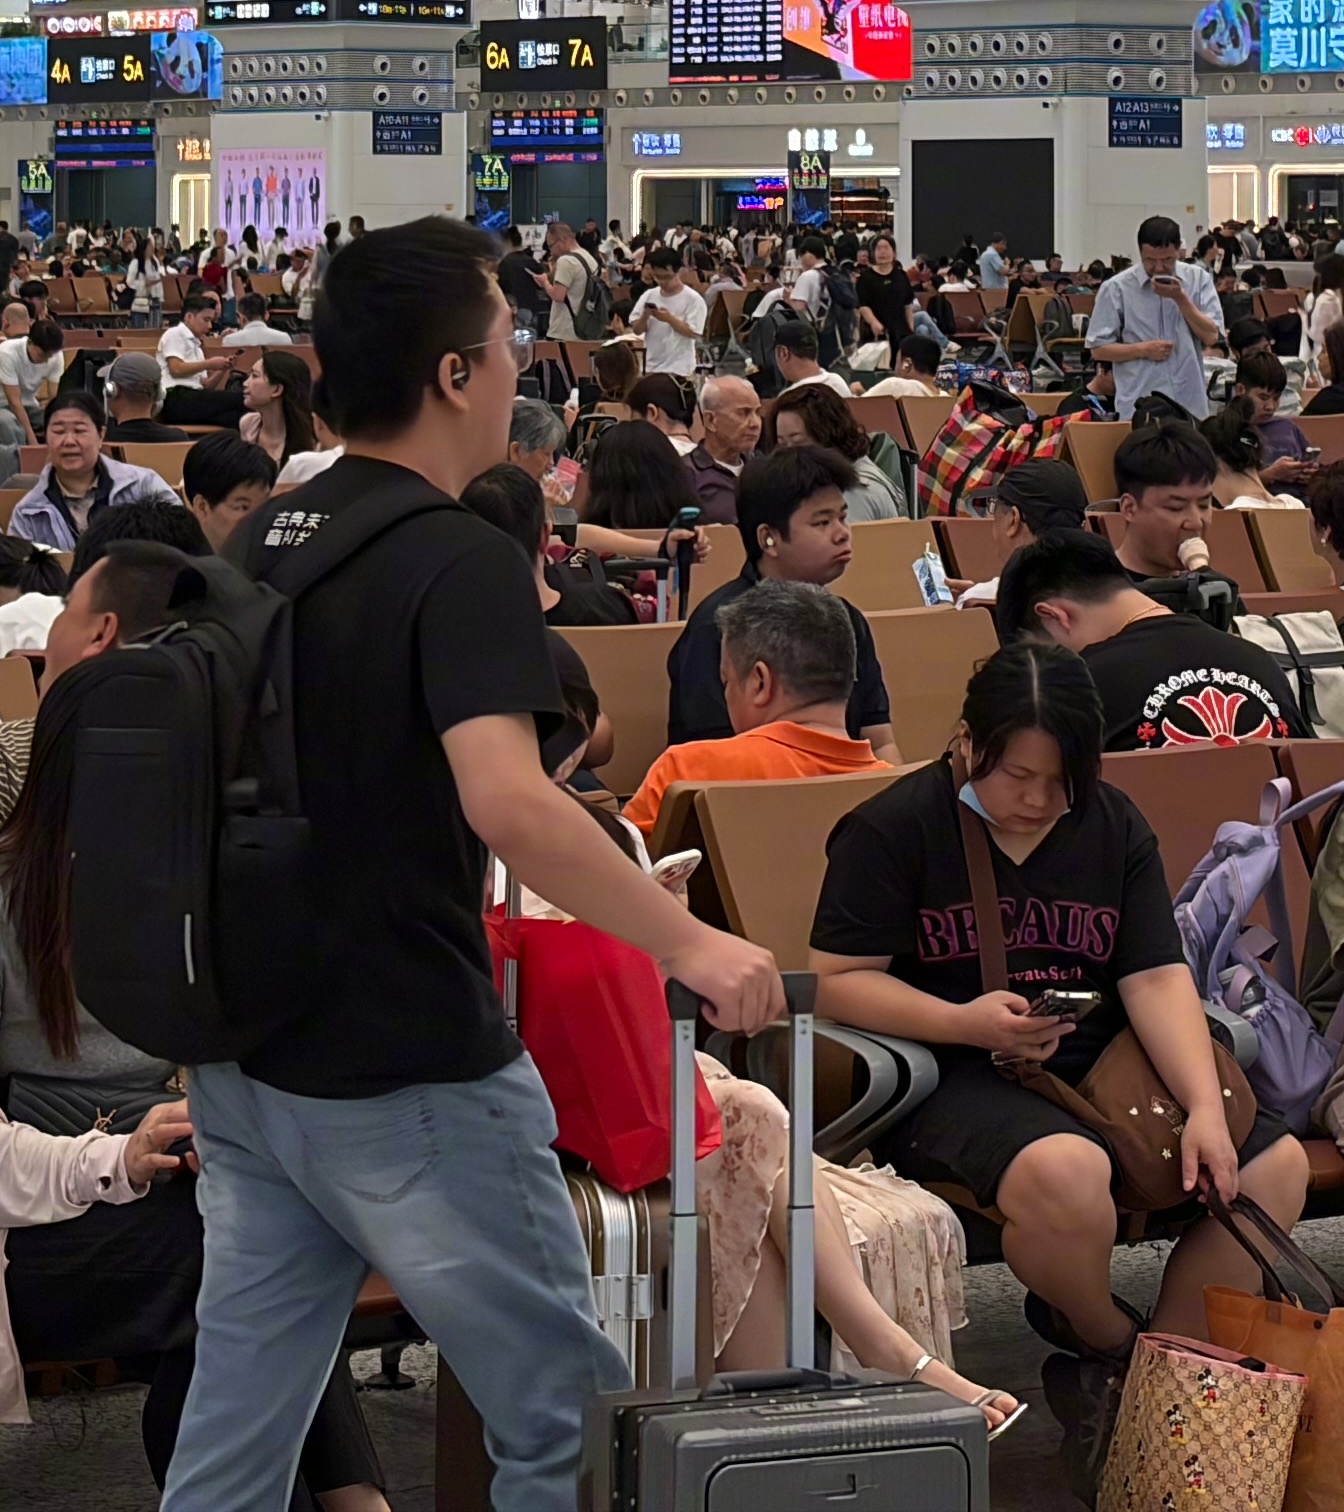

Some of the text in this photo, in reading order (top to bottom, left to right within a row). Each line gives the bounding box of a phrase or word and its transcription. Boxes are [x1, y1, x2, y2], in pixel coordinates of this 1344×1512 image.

[486, 42, 510, 70] 6A
[568, 38, 594, 68] 7A
[51, 57, 72, 84] 4A
[123, 55, 144, 82] 5A
[484, 157, 505, 174] 7A
[800, 156, 823, 171] 8A
[273, 511, 331, 530] 古典未
